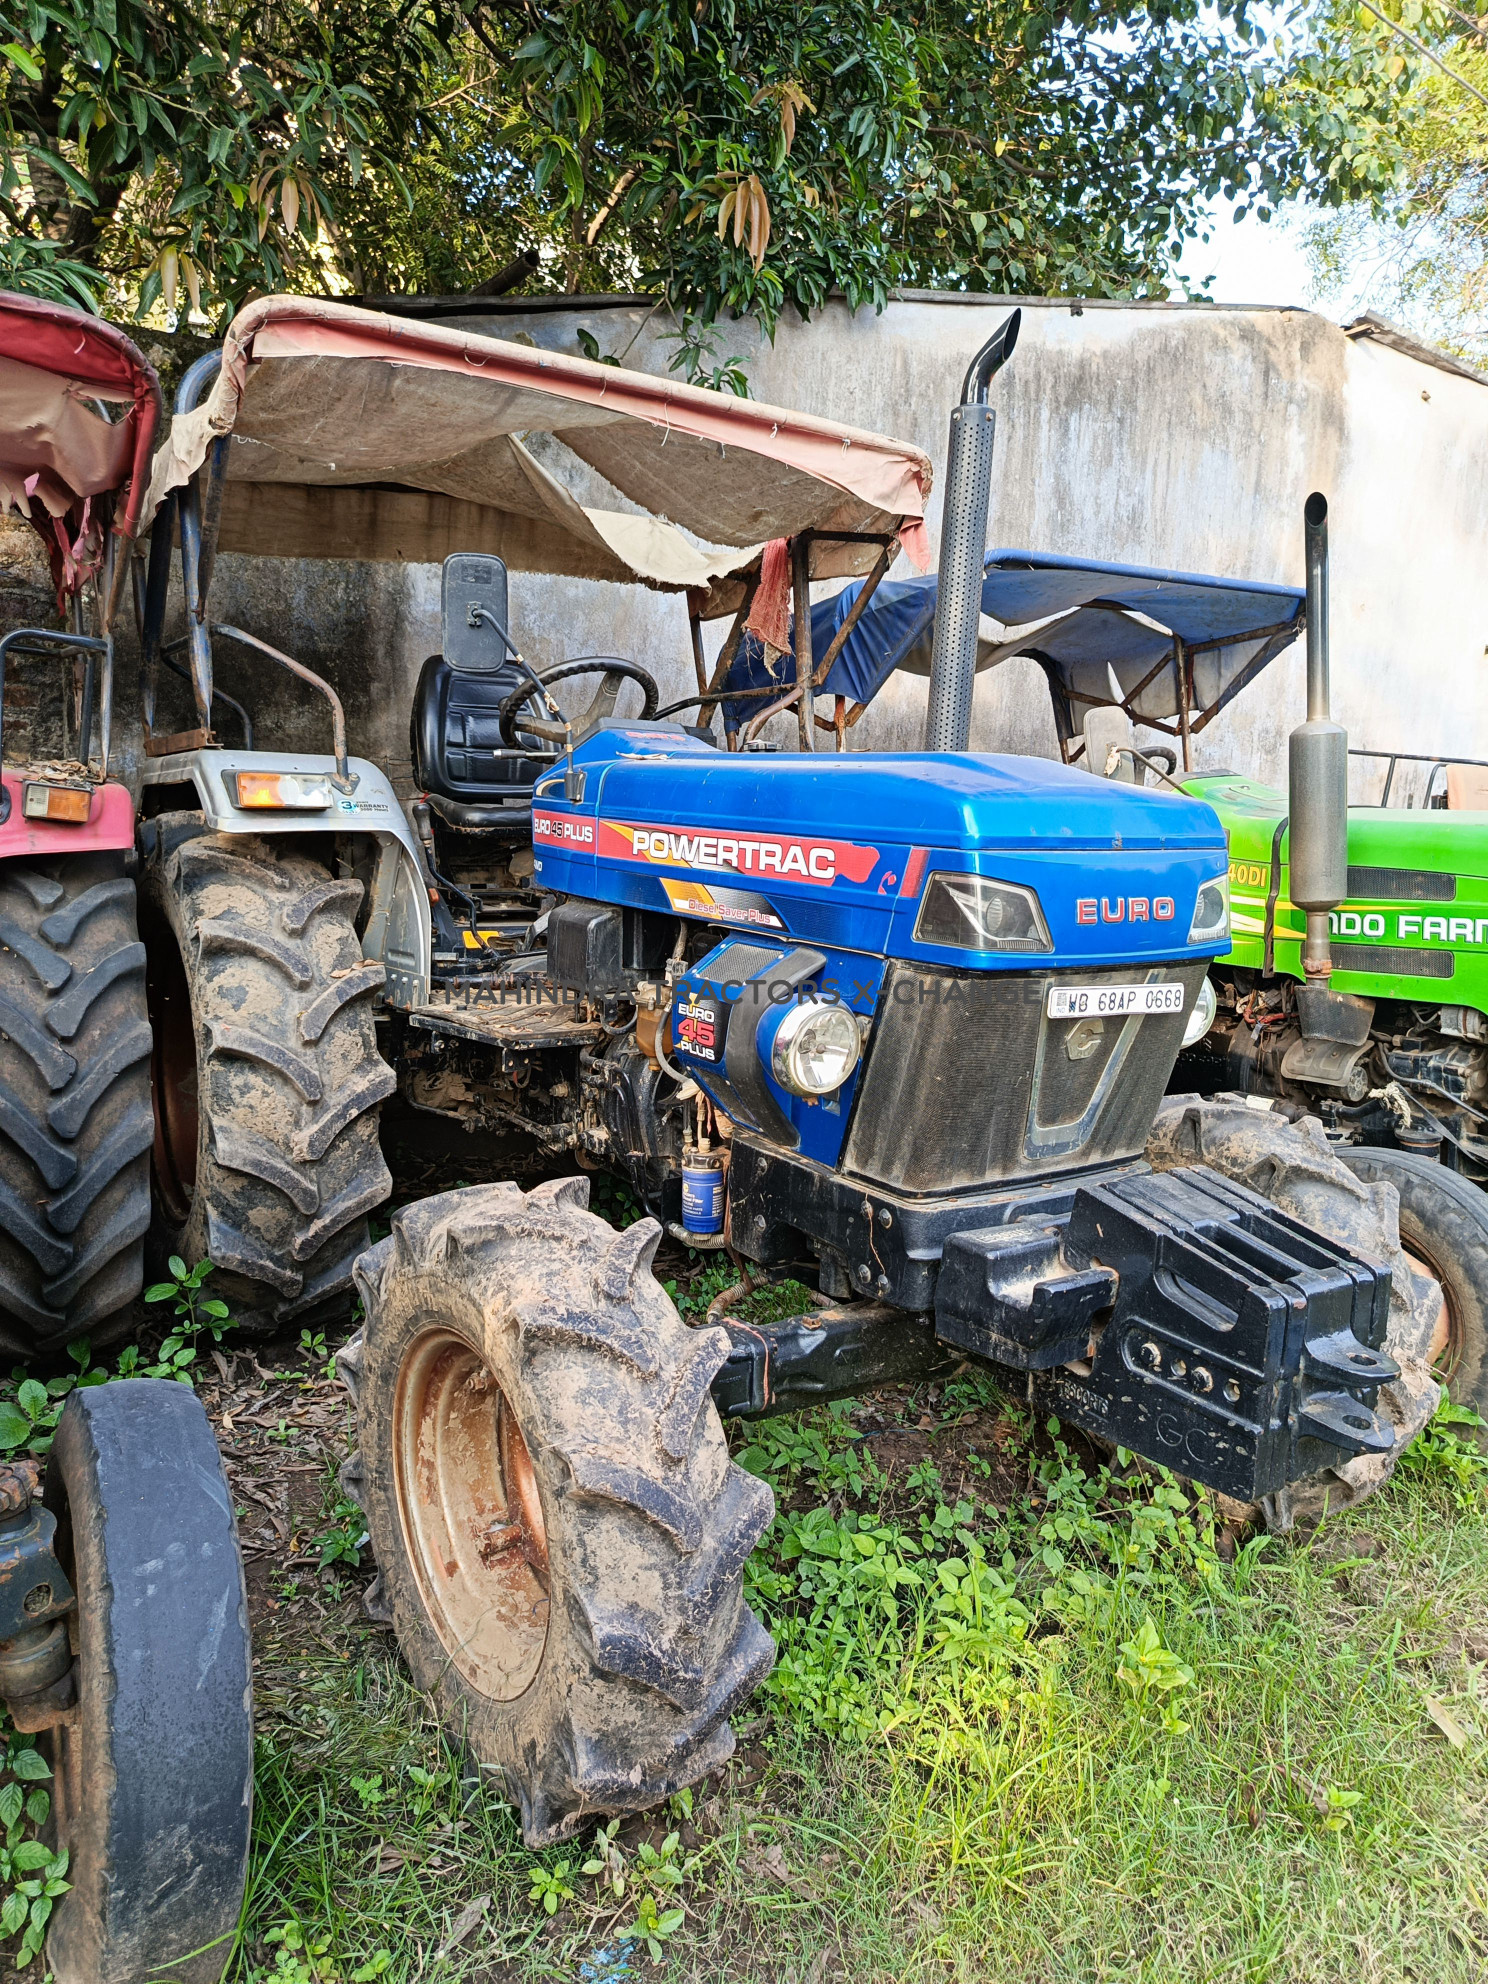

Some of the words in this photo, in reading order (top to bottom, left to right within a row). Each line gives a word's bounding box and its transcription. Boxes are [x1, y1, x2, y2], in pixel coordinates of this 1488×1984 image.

[534, 818, 551, 835] EURO
[551, 820, 563, 838] 45
[564, 823, 593, 843] PLUS
[632, 830, 836, 880] POWERTRAC
[688, 899, 717, 914] Diesel
[718, 904, 747, 919] Saver
[748, 908, 771, 924] Plus
[1076, 896, 1175, 925] EURO
[678, 1002, 715, 1023] EURO
[1098, 990, 1137, 1011] 68AP
[1145, 989, 1182, 1009] 0668
[678, 1018, 716, 1048] 45
[680, 1040, 716, 1061] PLUS
[1156, 1413, 1208, 1463] GC
